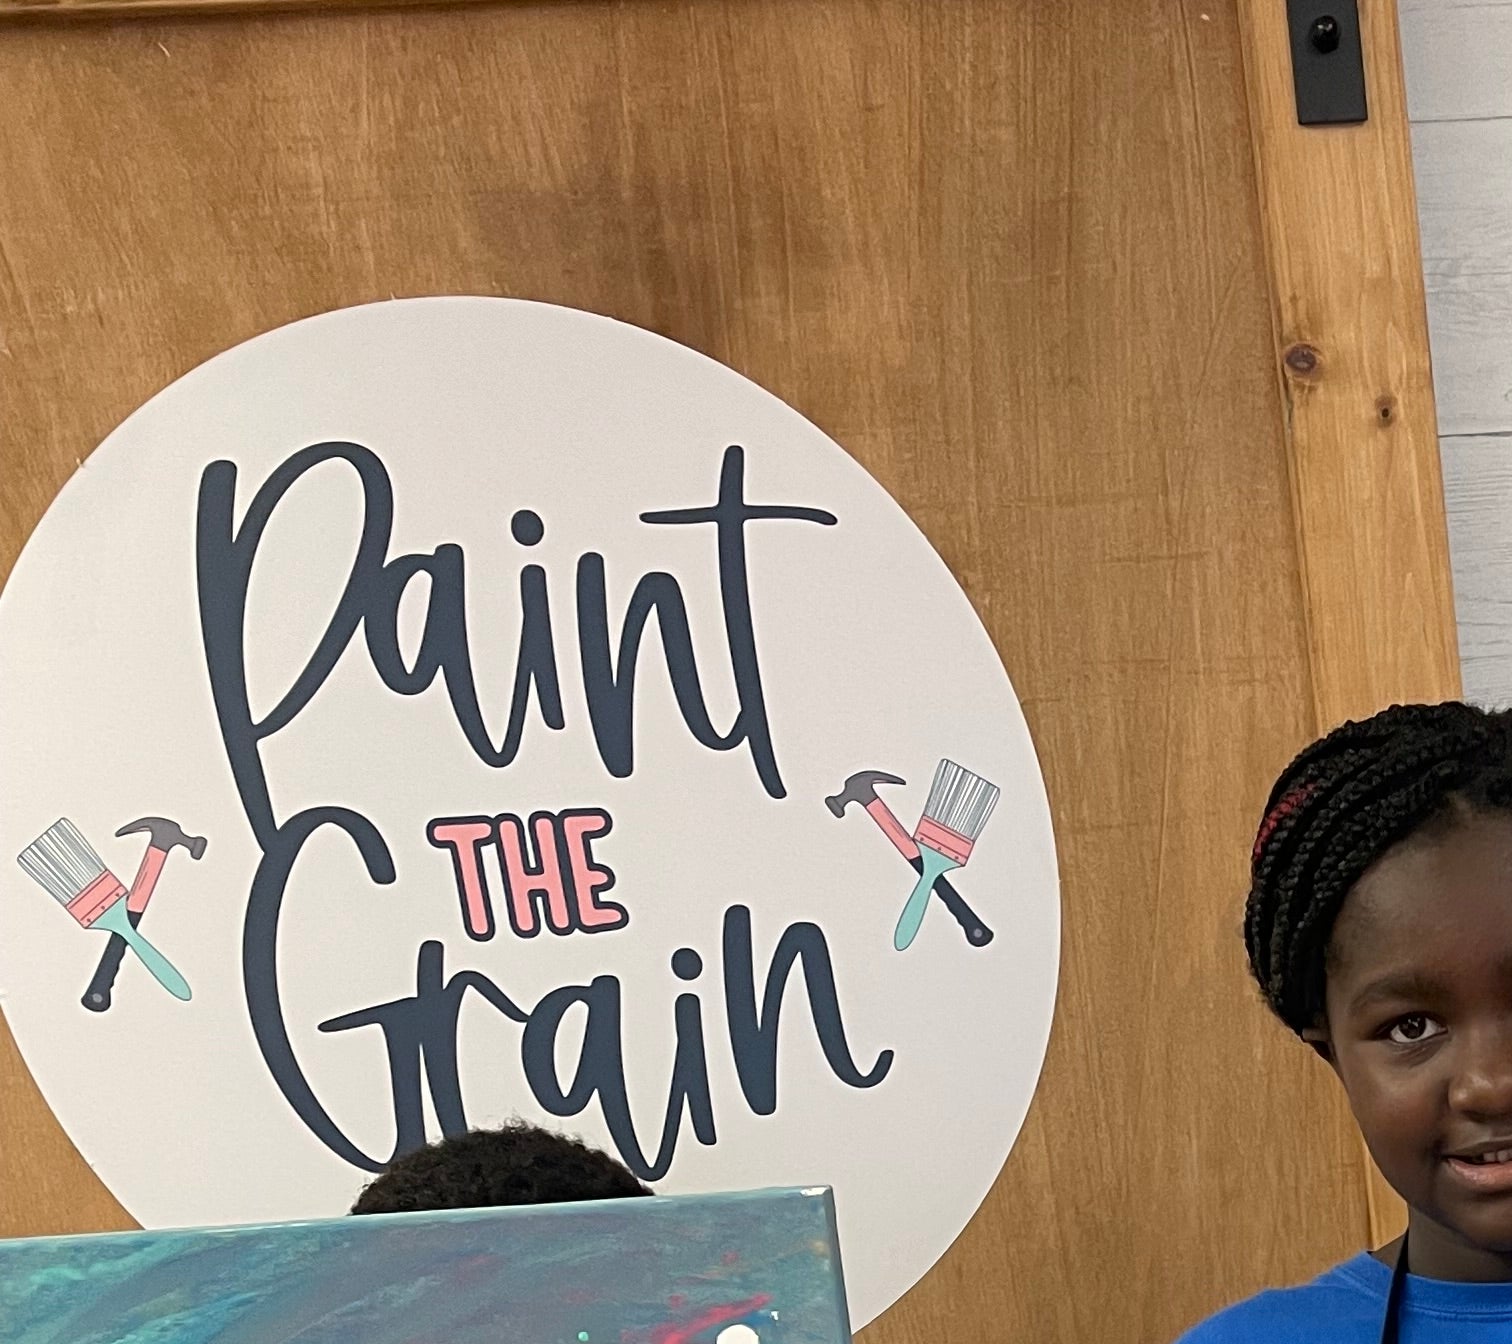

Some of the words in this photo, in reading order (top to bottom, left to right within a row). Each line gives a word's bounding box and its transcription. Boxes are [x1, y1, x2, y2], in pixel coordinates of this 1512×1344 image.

[196, 441, 838, 855] Paint
[242, 806, 894, 1181] Grain
[426, 808, 629, 942] THE
